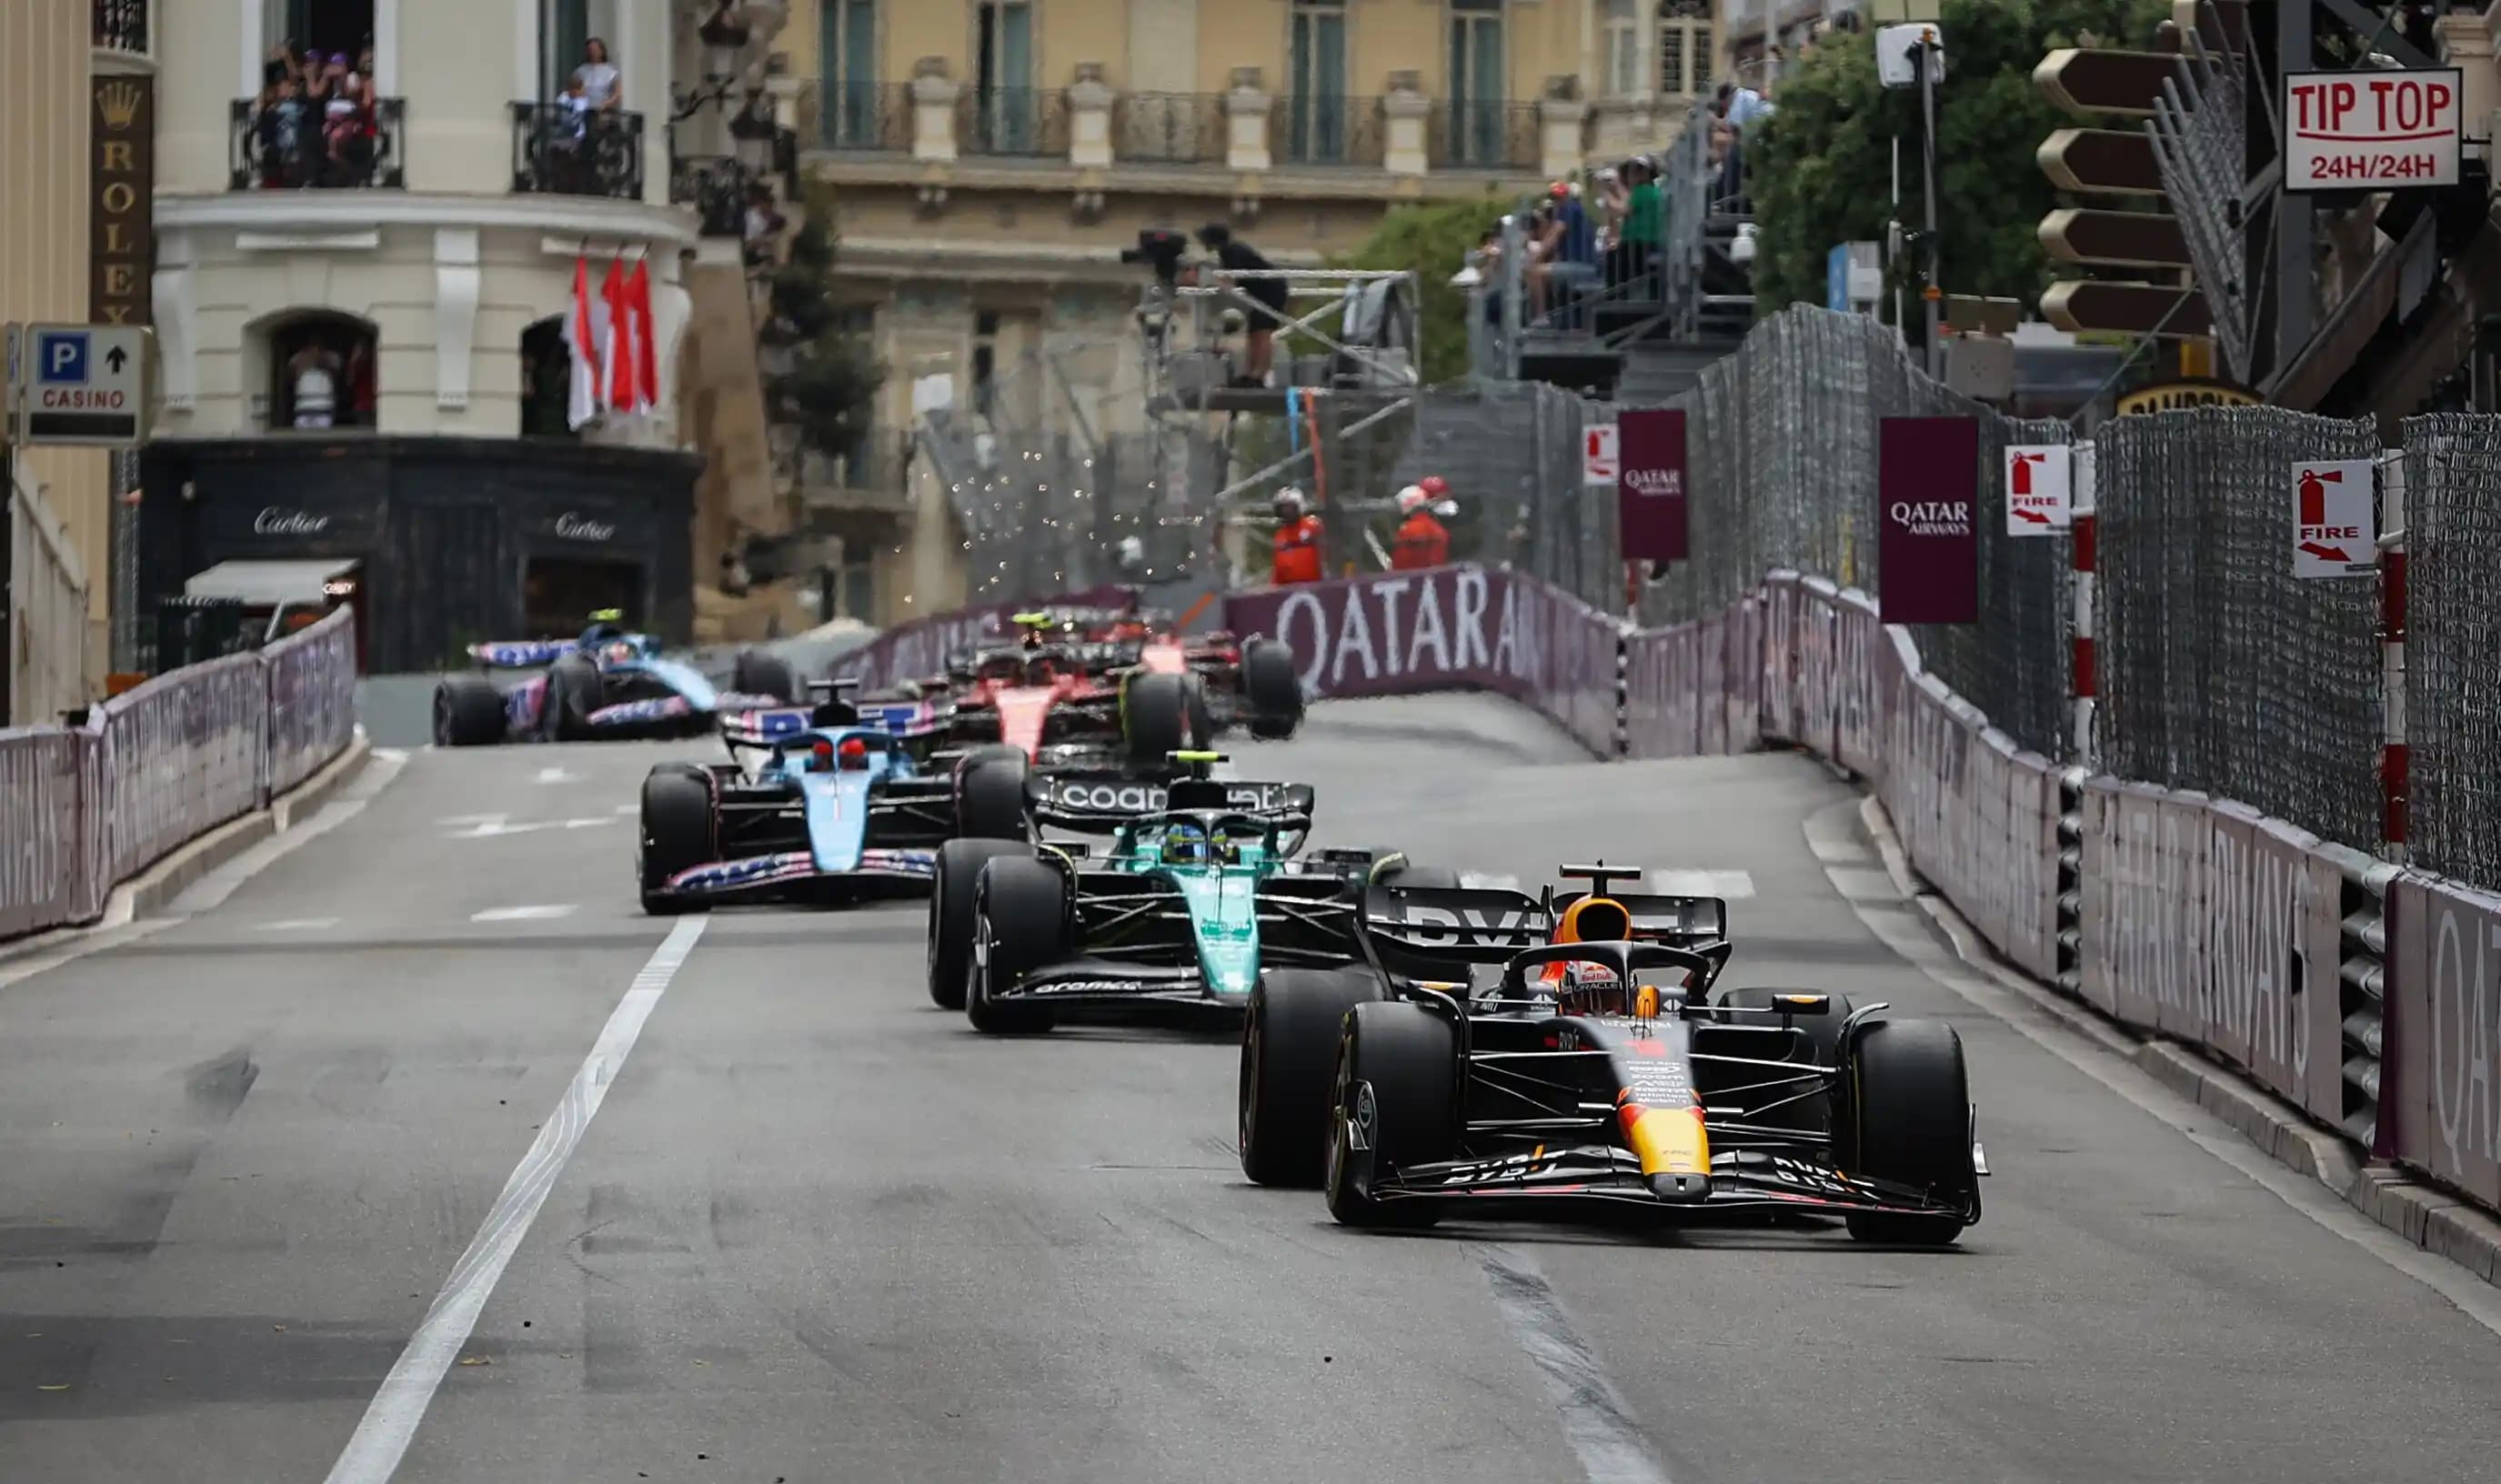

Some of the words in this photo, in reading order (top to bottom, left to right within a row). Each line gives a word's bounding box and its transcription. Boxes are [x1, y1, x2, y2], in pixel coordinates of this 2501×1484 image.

[2292, 83, 2355, 131] TIP
[2369, 81, 2450, 131] TOP
[2311, 155, 2435, 178] 24H/24H
[102, 140, 136, 325] ROLEX
[53, 342, 77, 374] P
[43, 389, 125, 408] CASINO
[1624, 469, 1681, 488] QATAR
[2012, 496, 2058, 506] FIRE
[255, 506, 329, 534] Cartier
[1891, 502, 1968, 526] QATAR
[1909, 522, 1970, 535] AIRWAYS
[2300, 527, 2359, 540] FIRE
[1277, 571, 1489, 699] QATAR
